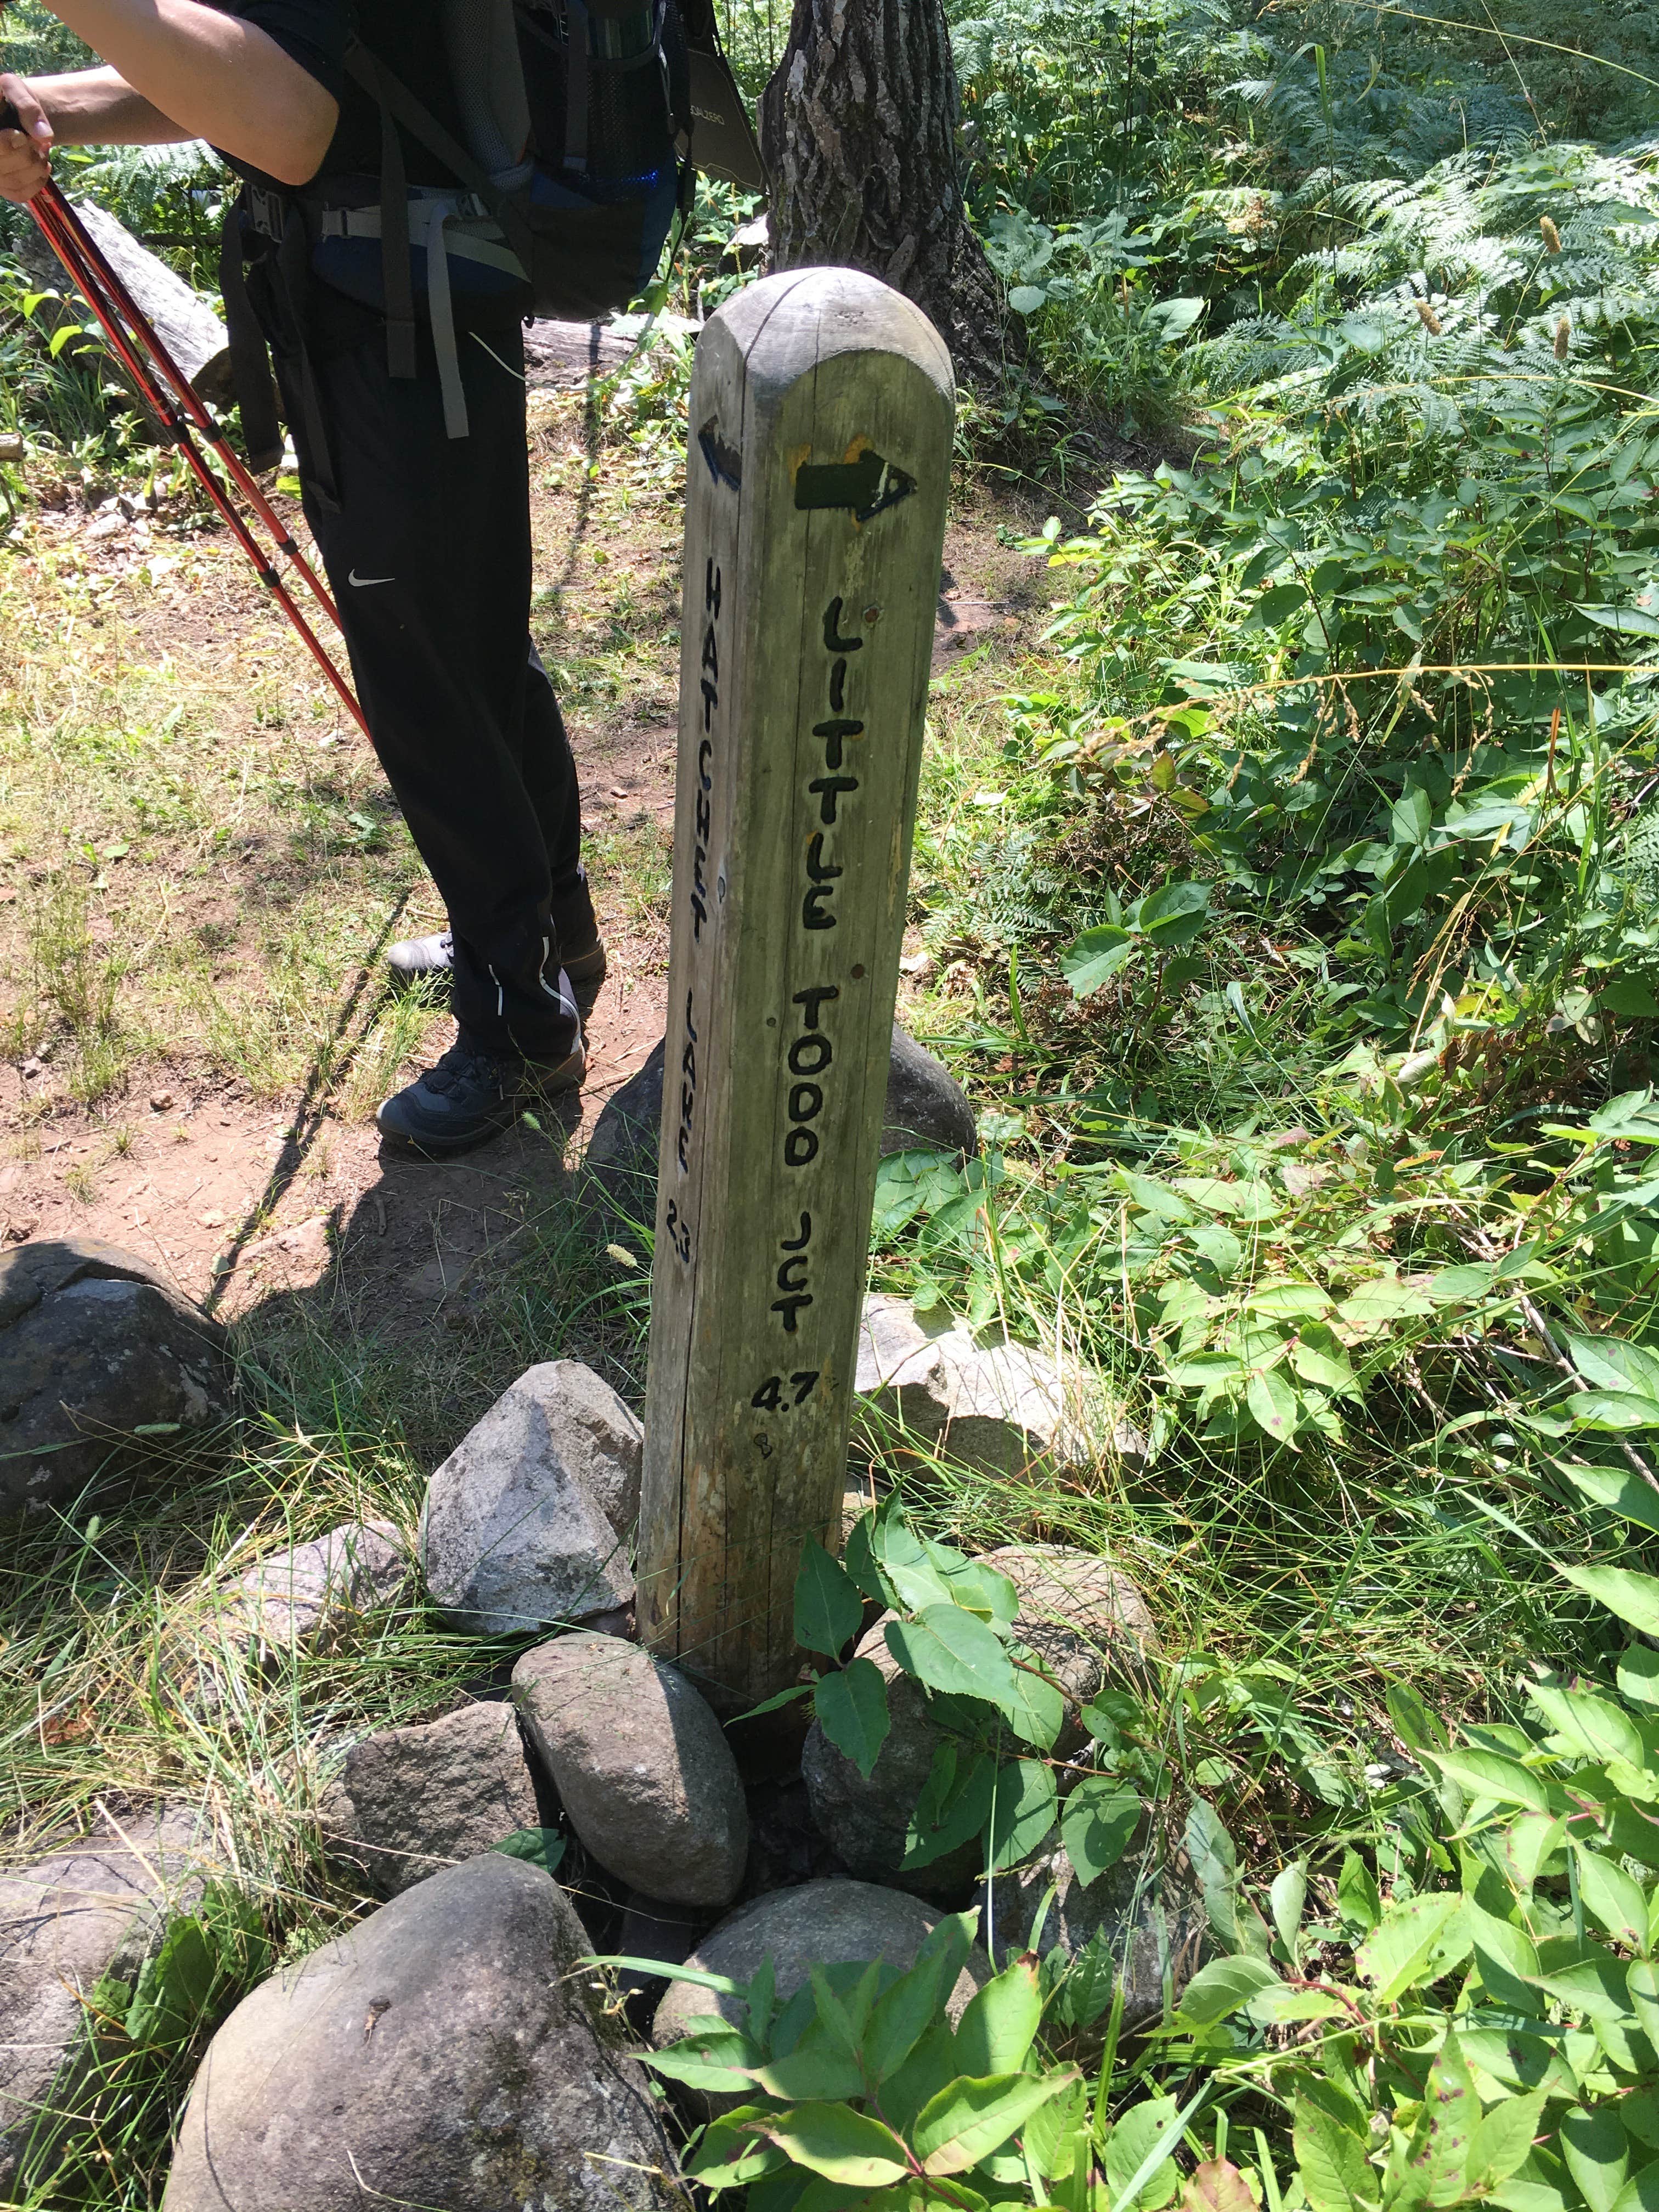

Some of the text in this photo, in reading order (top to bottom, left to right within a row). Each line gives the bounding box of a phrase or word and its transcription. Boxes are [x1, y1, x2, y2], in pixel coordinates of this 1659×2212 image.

[678, 557, 721, 1174] HATCHET LAKE
[770, 595, 865, 1333] LITTLE TODD JCT
[751, 1371, 820, 1413] 4.7
